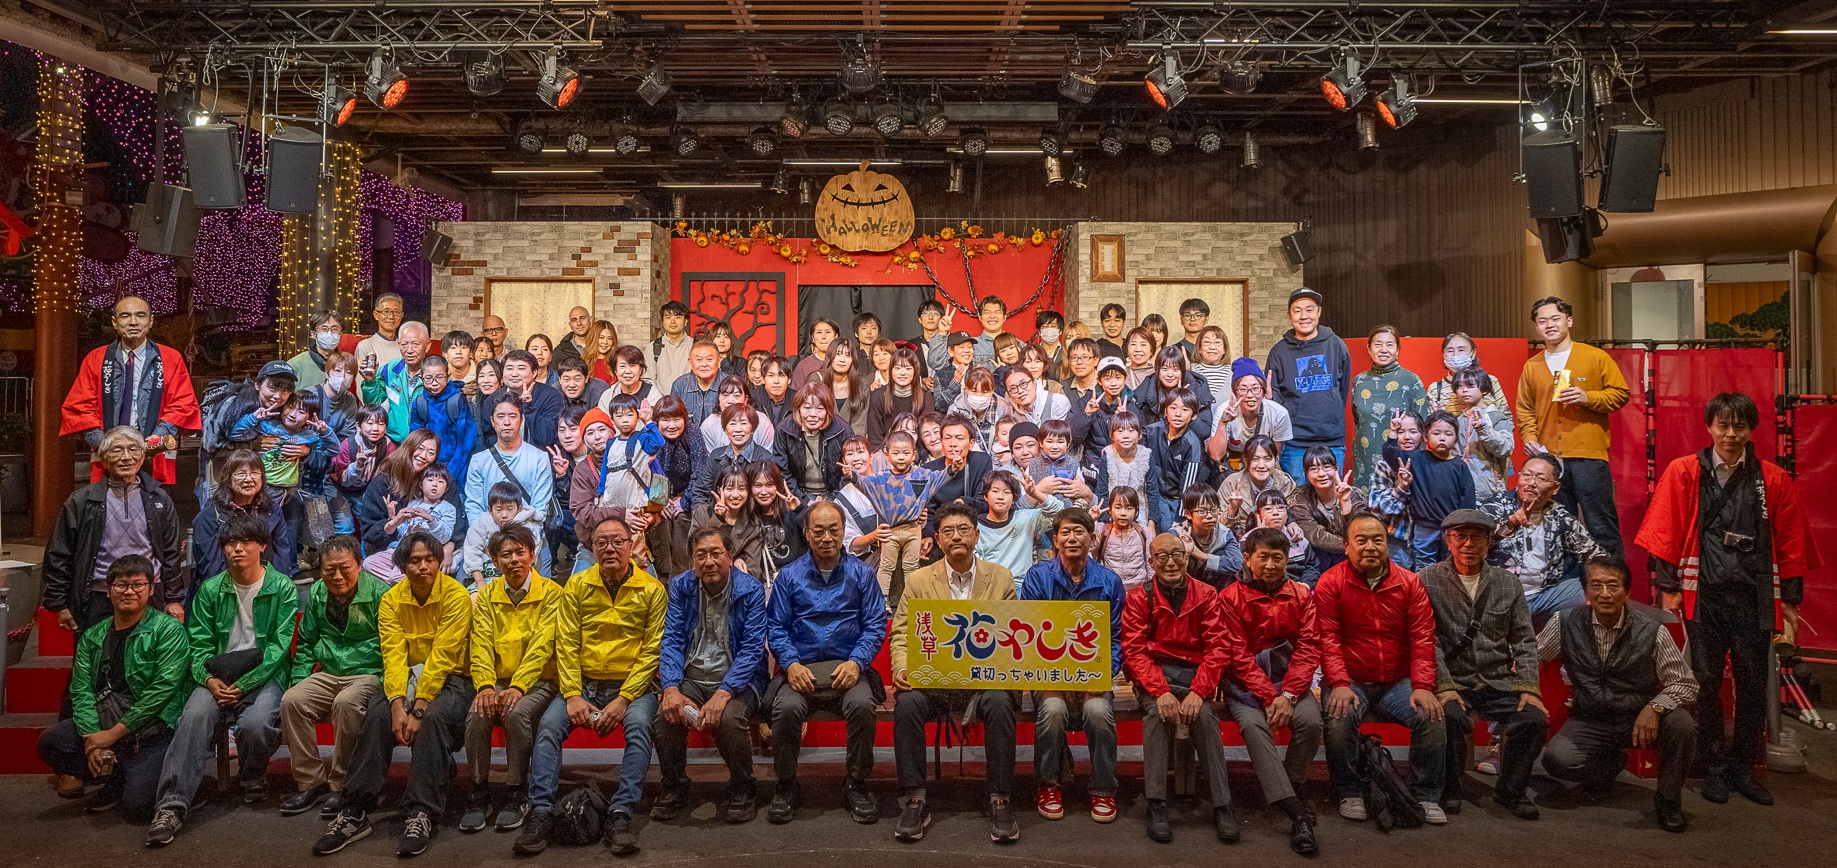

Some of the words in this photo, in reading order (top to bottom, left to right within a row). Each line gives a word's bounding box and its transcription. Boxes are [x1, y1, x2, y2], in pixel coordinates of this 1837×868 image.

[820, 213, 911, 237] HALLOWEEN
[915, 611, 938, 661] 浅草
[938, 611, 1099, 661] 花やしき
